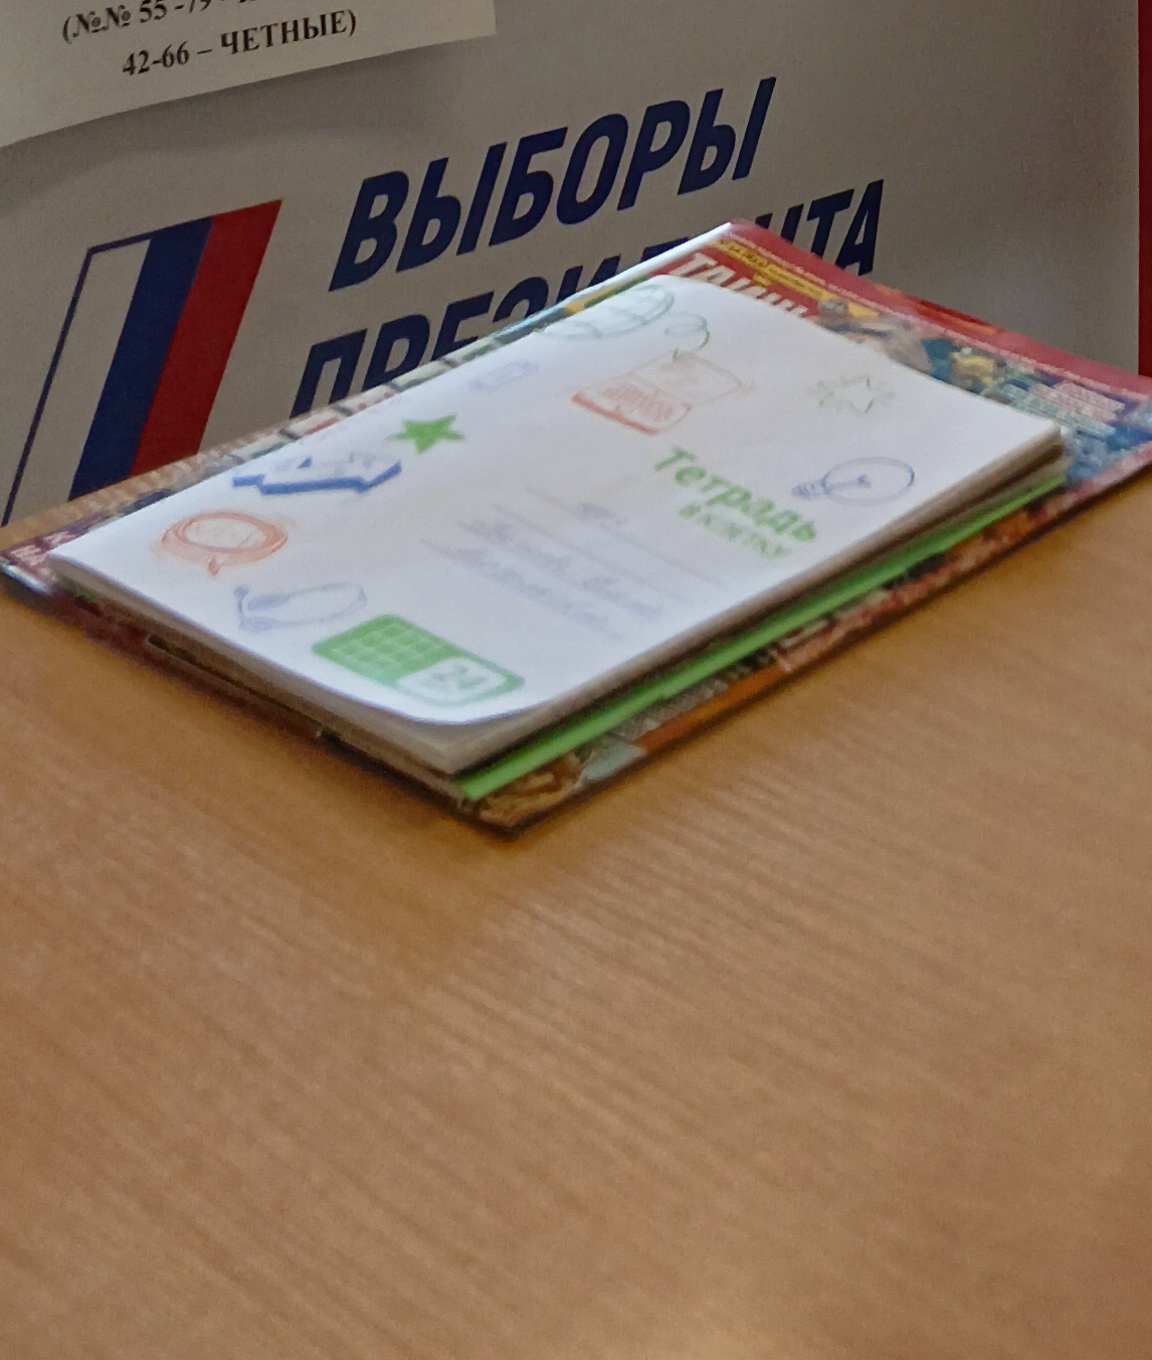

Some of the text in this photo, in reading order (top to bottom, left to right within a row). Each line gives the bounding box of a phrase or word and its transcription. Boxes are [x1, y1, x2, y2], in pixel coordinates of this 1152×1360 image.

[122, 40, 191, 77] 42-66
[221, 9, 357, 55] ЧЕТНЫЕ)
[328, 76, 777, 292] ВЫБОРЫ
